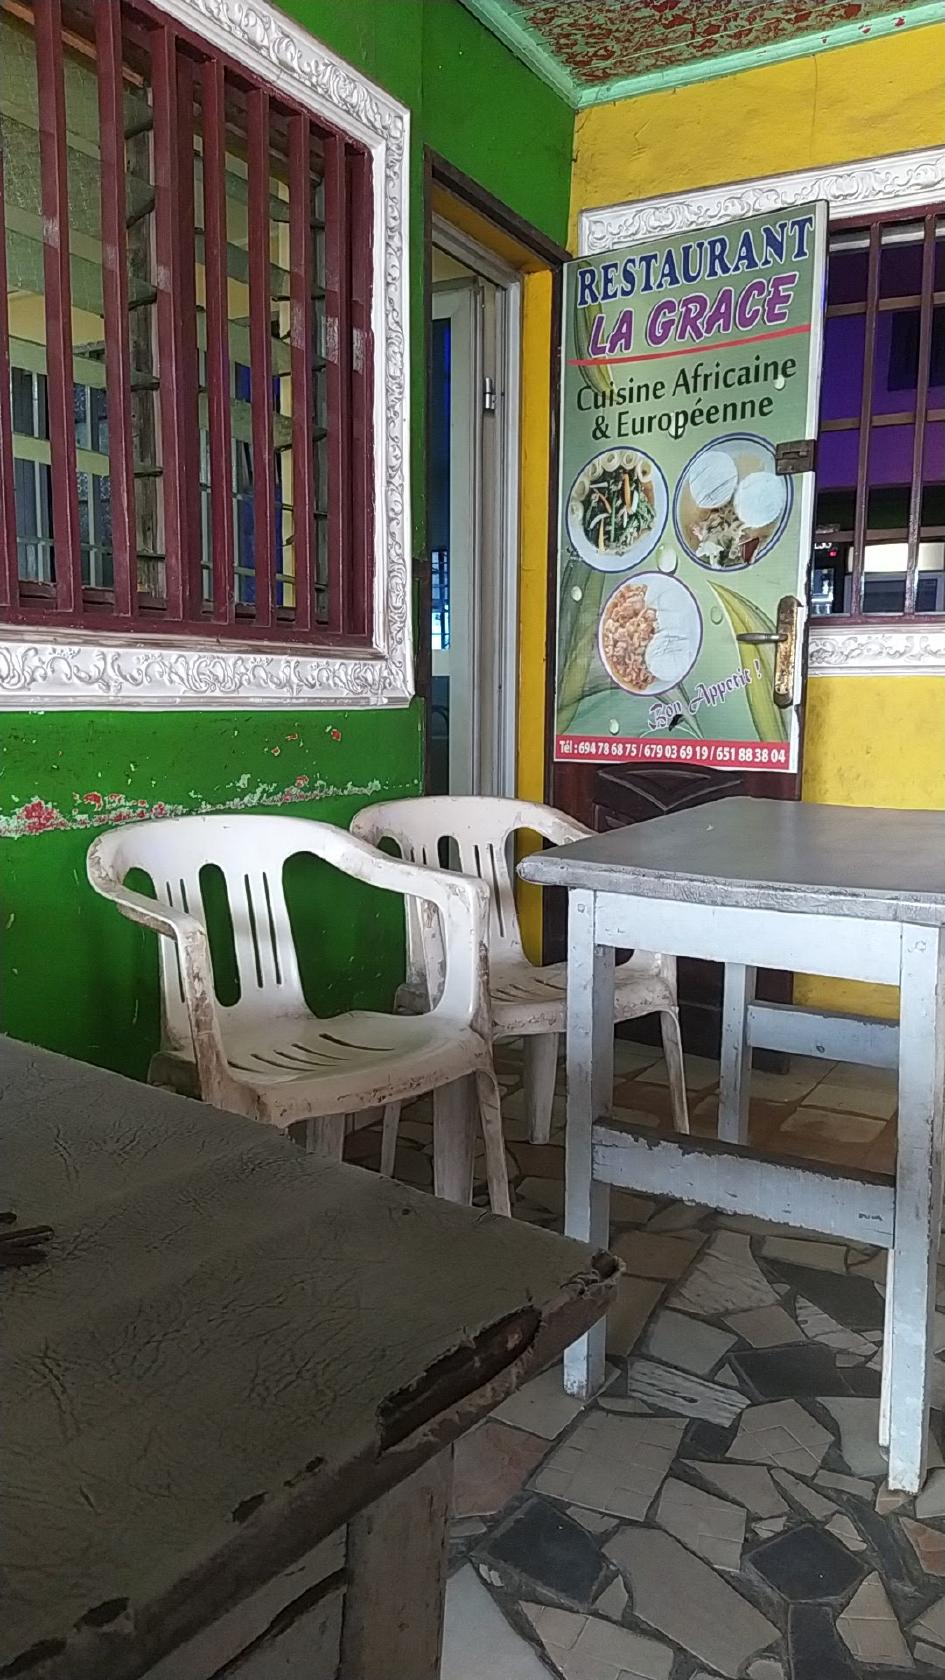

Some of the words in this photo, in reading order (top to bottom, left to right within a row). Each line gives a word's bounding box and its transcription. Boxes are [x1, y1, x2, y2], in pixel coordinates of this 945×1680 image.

[577, 215, 815, 308] RESTAURANT
[588, 309, 634, 359] LA
[645, 272, 799, 347] GRACE
[576, 376, 666, 411] Cuisine
[672, 354, 797, 397] Africaine
[591, 415, 611, 440] &
[617, 395, 774, 440] Européenne
[647, 701, 683, 730] Bon
[559, 740, 573, 754] Tél
[597, 742, 610, 755] 78
[611, 743, 623, 756] 68
[625, 744, 637, 757] 75
[644, 744, 663, 758] 679
[664, 745, 678, 759] 03
[679, 745, 693, 760] 69
[695, 745, 709, 760] 19
[716, 747, 736, 761] 651
[738, 747, 753, 762] 88
[753, 748, 769, 763] 38
[770, 749, 786, 763] 04
